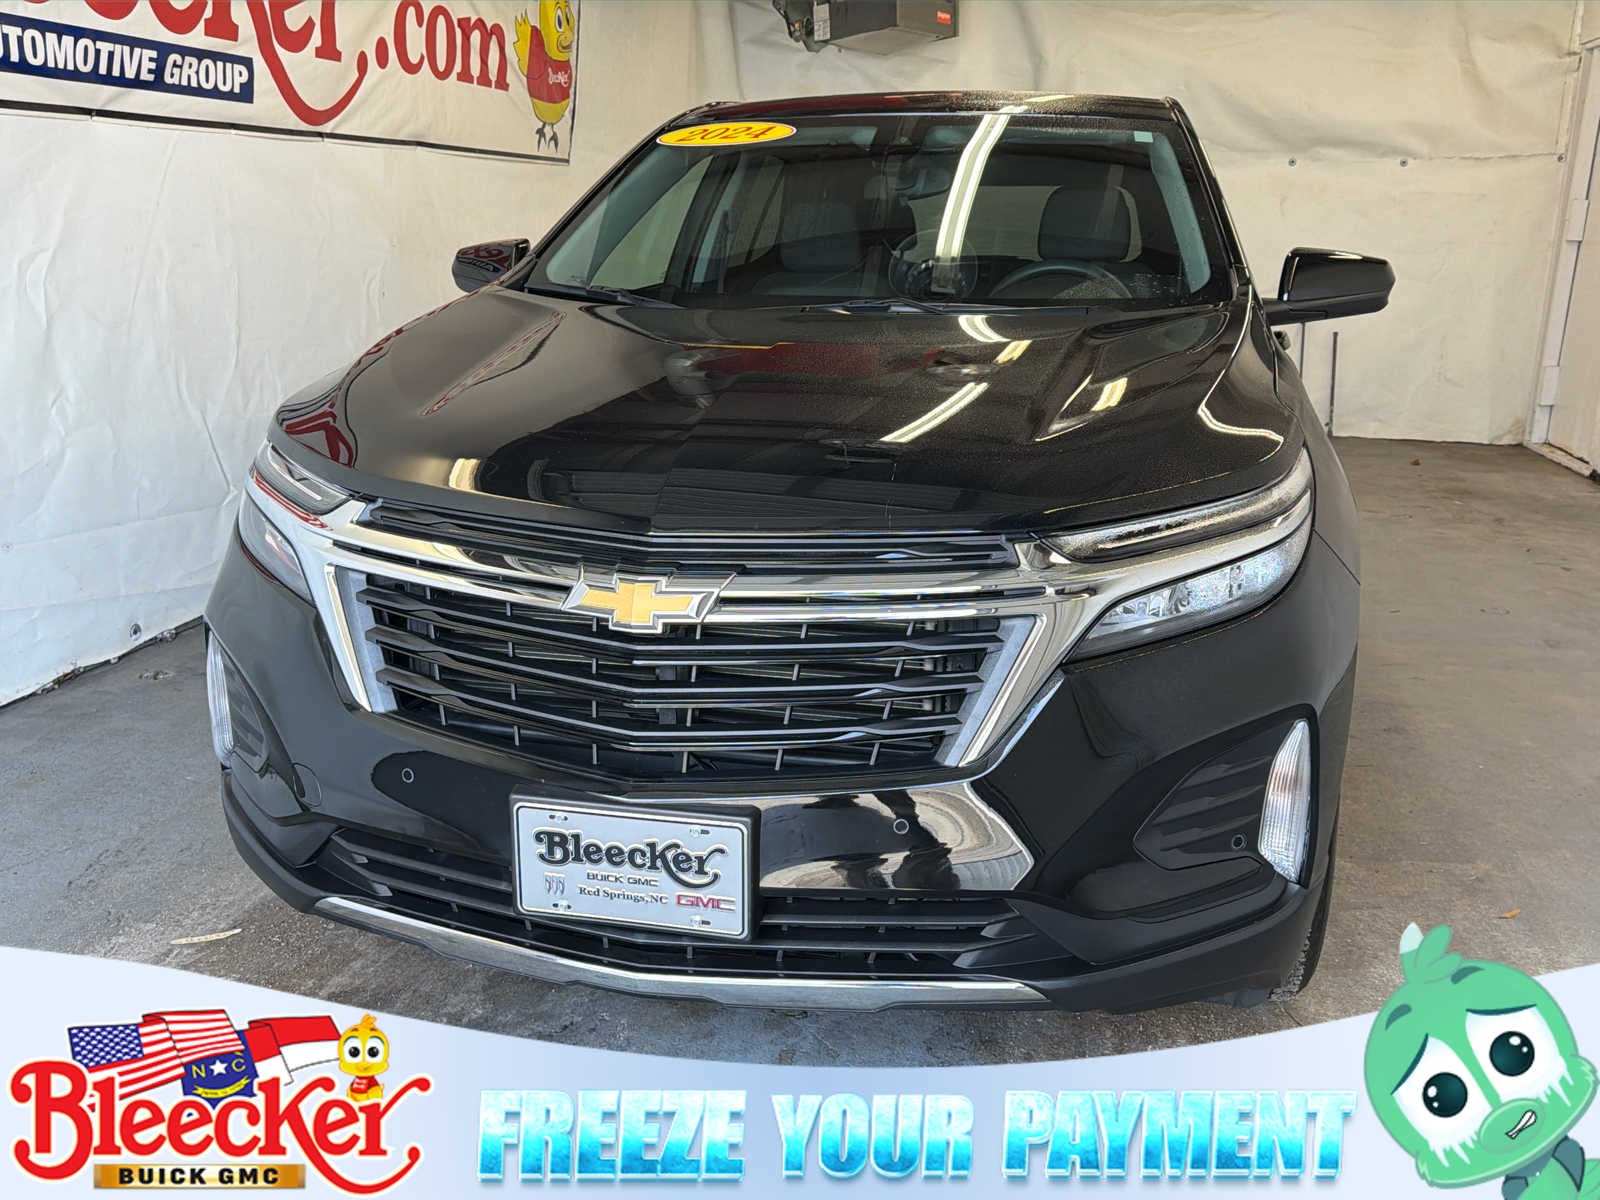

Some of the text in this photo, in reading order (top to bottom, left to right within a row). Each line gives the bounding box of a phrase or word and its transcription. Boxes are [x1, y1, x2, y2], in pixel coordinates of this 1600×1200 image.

[0, 23, 249, 94] TOMOTIVE GROUP
[675, 125, 776, 143] 2024
[533, 829, 726, 889] Bleecker
[586, 871, 659, 887] BUICK GMC
[577, 886, 600, 897] Red
[675, 893, 737, 912] GMC
